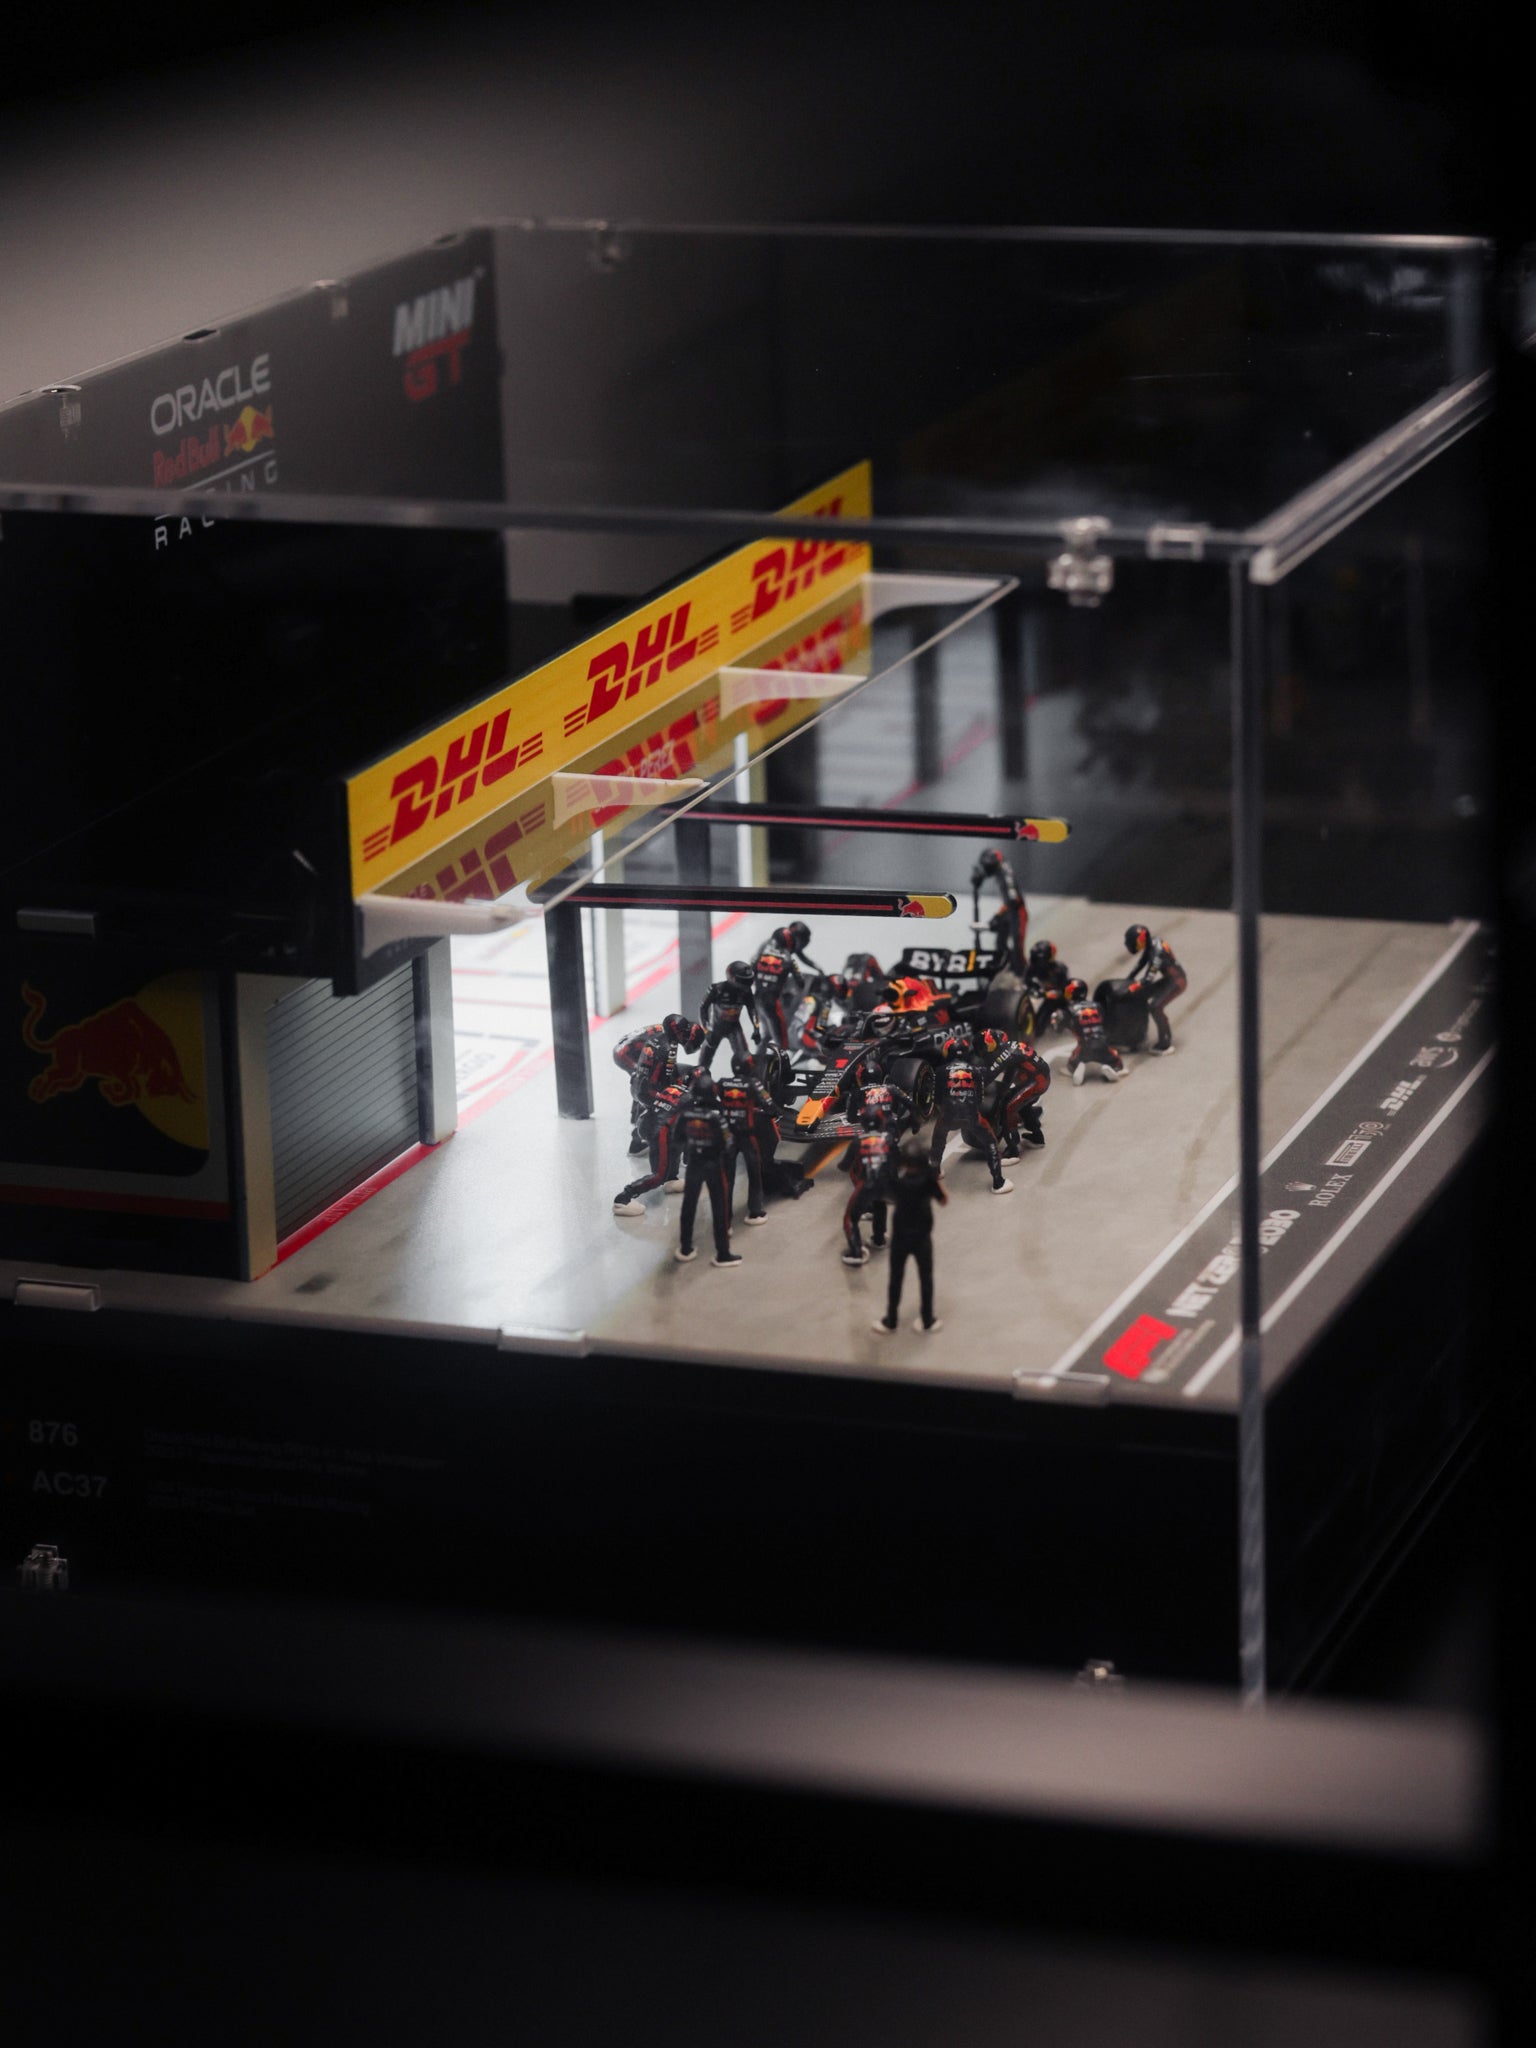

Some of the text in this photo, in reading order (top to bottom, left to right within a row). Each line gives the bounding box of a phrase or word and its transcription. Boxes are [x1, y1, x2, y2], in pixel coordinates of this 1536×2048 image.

[393, 277, 475, 356] MINI
[404, 330, 470, 400] GT
[150, 353, 271, 436] ORACLE
[750, 494, 845, 622] DHL
[586, 602, 700, 725] DHL
[389, 708, 520, 847] DHL
[909, 950, 994, 973] BYBIT
[1380, 1080, 1422, 1111] DHL
[1308, 1173, 1353, 1207] ROLEX
[1166, 1282, 1218, 1317] NET
[28, 1419, 79, 1447] 876
[32, 1469, 108, 1498] AC37
